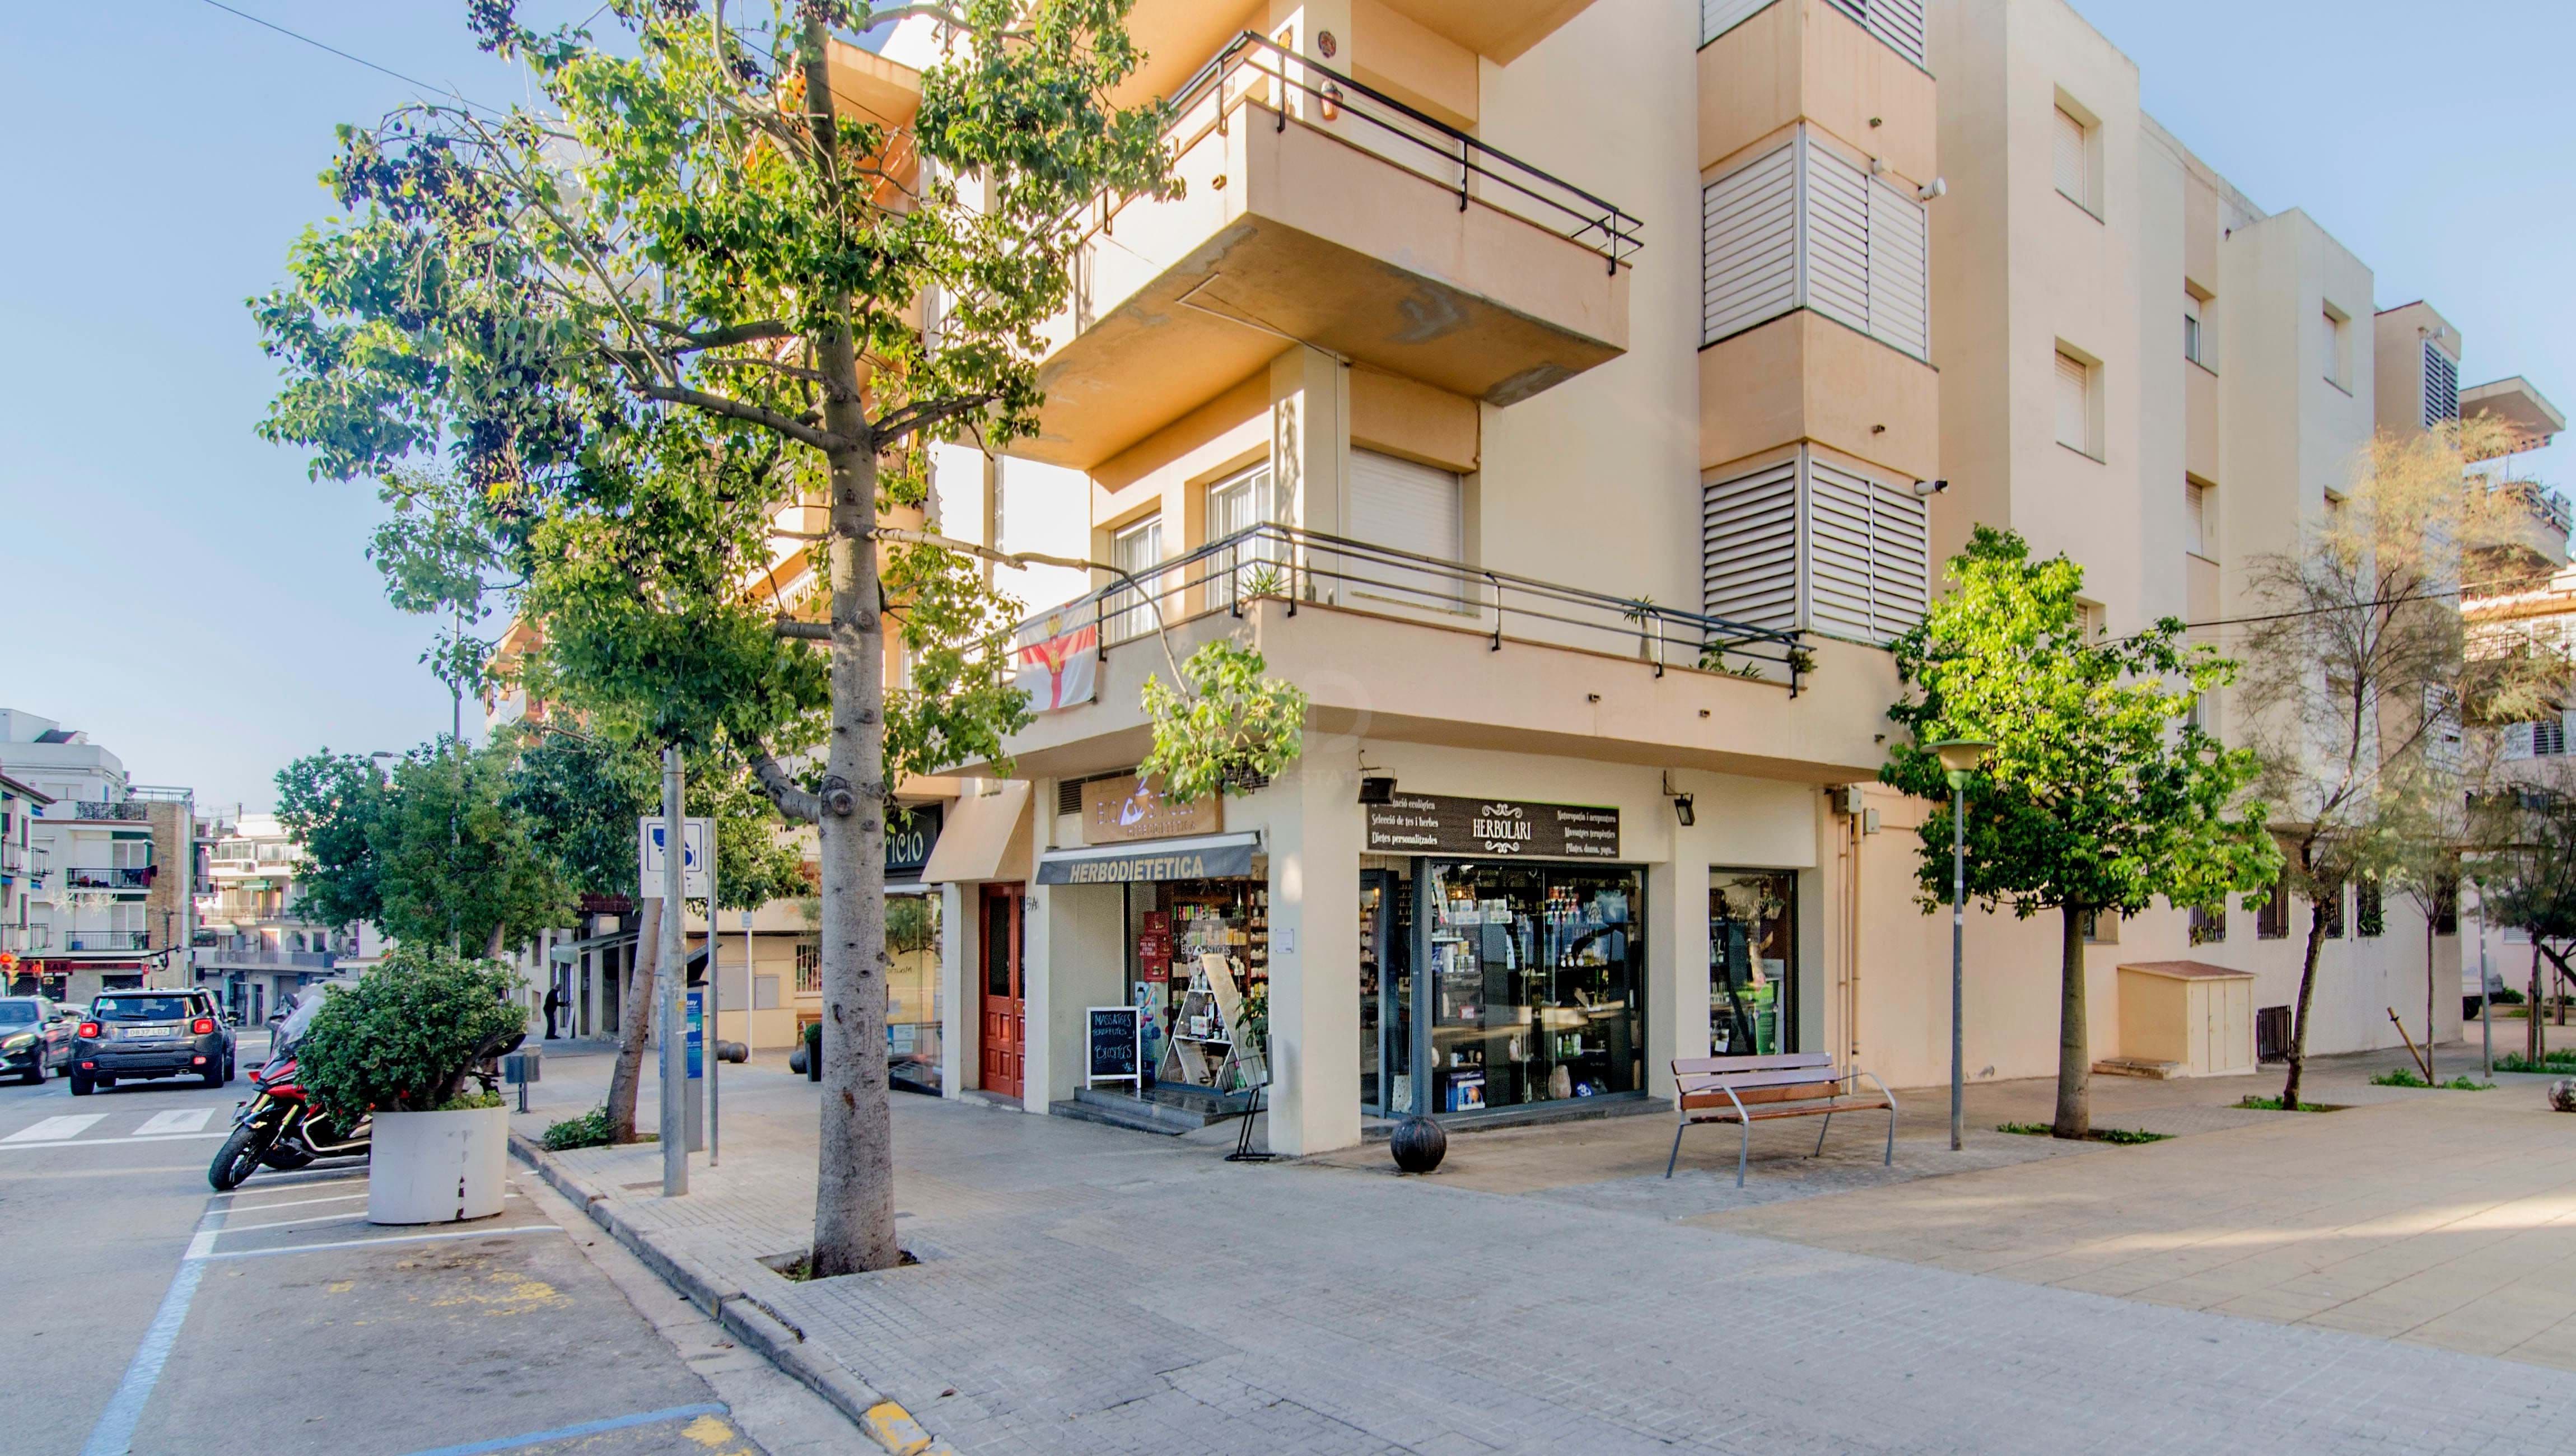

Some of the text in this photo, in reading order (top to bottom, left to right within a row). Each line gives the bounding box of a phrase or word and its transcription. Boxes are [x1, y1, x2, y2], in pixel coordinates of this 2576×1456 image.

[1371, 813, 1396, 825] Selecció
[1397, 815, 1404, 825] de
[1405, 817, 1414, 827] tes
[1419, 816, 1439, 828] herbes
[1473, 818, 1530, 839] HERBOLARI
[1372, 832, 1438, 845] Dietes personalitzades
[1070, 855, 1204, 884] HERBODIETETICA
